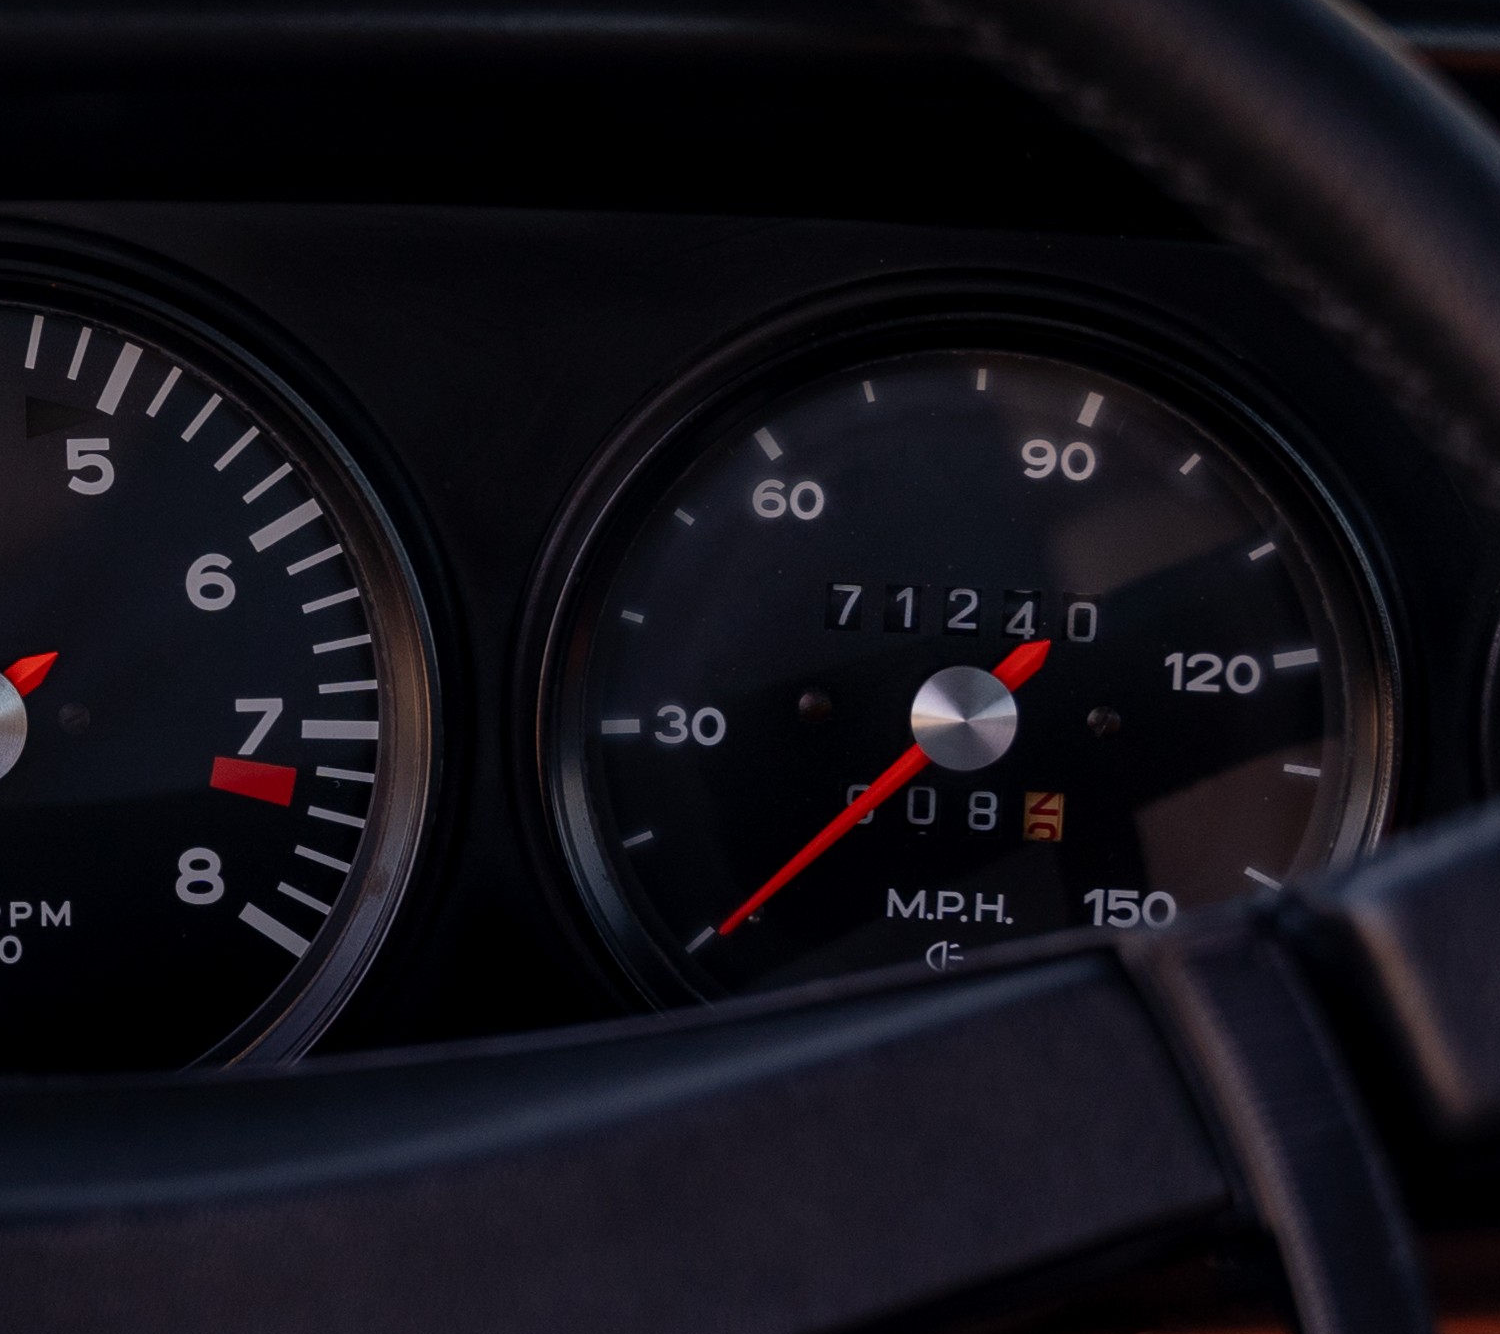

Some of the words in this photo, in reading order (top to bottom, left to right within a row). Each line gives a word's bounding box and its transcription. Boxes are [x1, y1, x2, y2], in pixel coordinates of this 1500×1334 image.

[67, 437, 115, 495] 5
[1021, 438, 1096, 482] 90
[752, 479, 825, 522] 60
[185, 553, 236, 611] 6
[1164, 652, 1263, 695] 120
[236, 698, 283, 755] 7
[653, 704, 726, 746] 30
[175, 847, 225, 905] 8
[886, 887, 1014, 925] M.P.H.
[1083, 888, 1177, 930] 150
